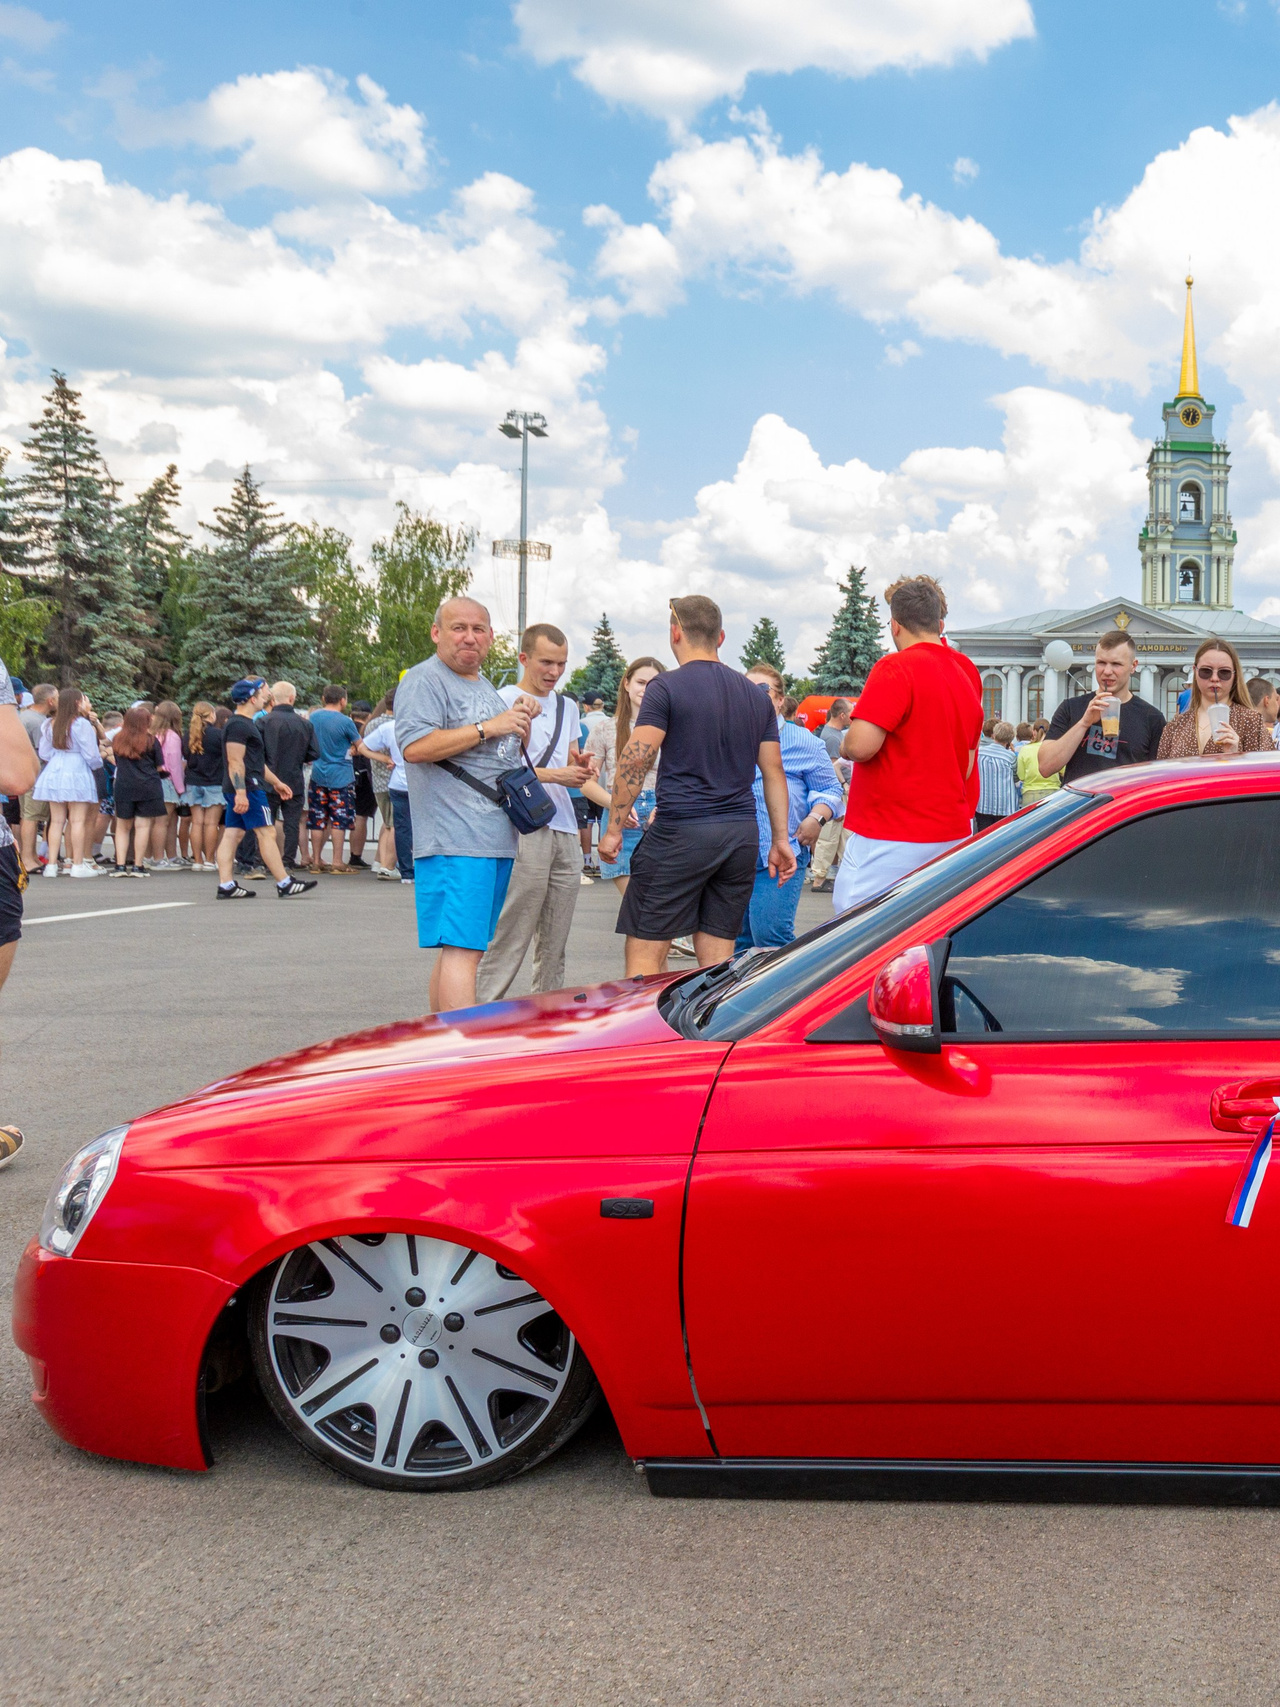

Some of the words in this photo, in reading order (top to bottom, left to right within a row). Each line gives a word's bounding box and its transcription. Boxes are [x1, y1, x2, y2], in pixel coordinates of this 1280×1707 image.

[1072, 643, 1083, 652] ЕЙ
[1136, 644, 1188, 652] САМОВАРЫ»
[1092, 741, 1113, 753] GO
